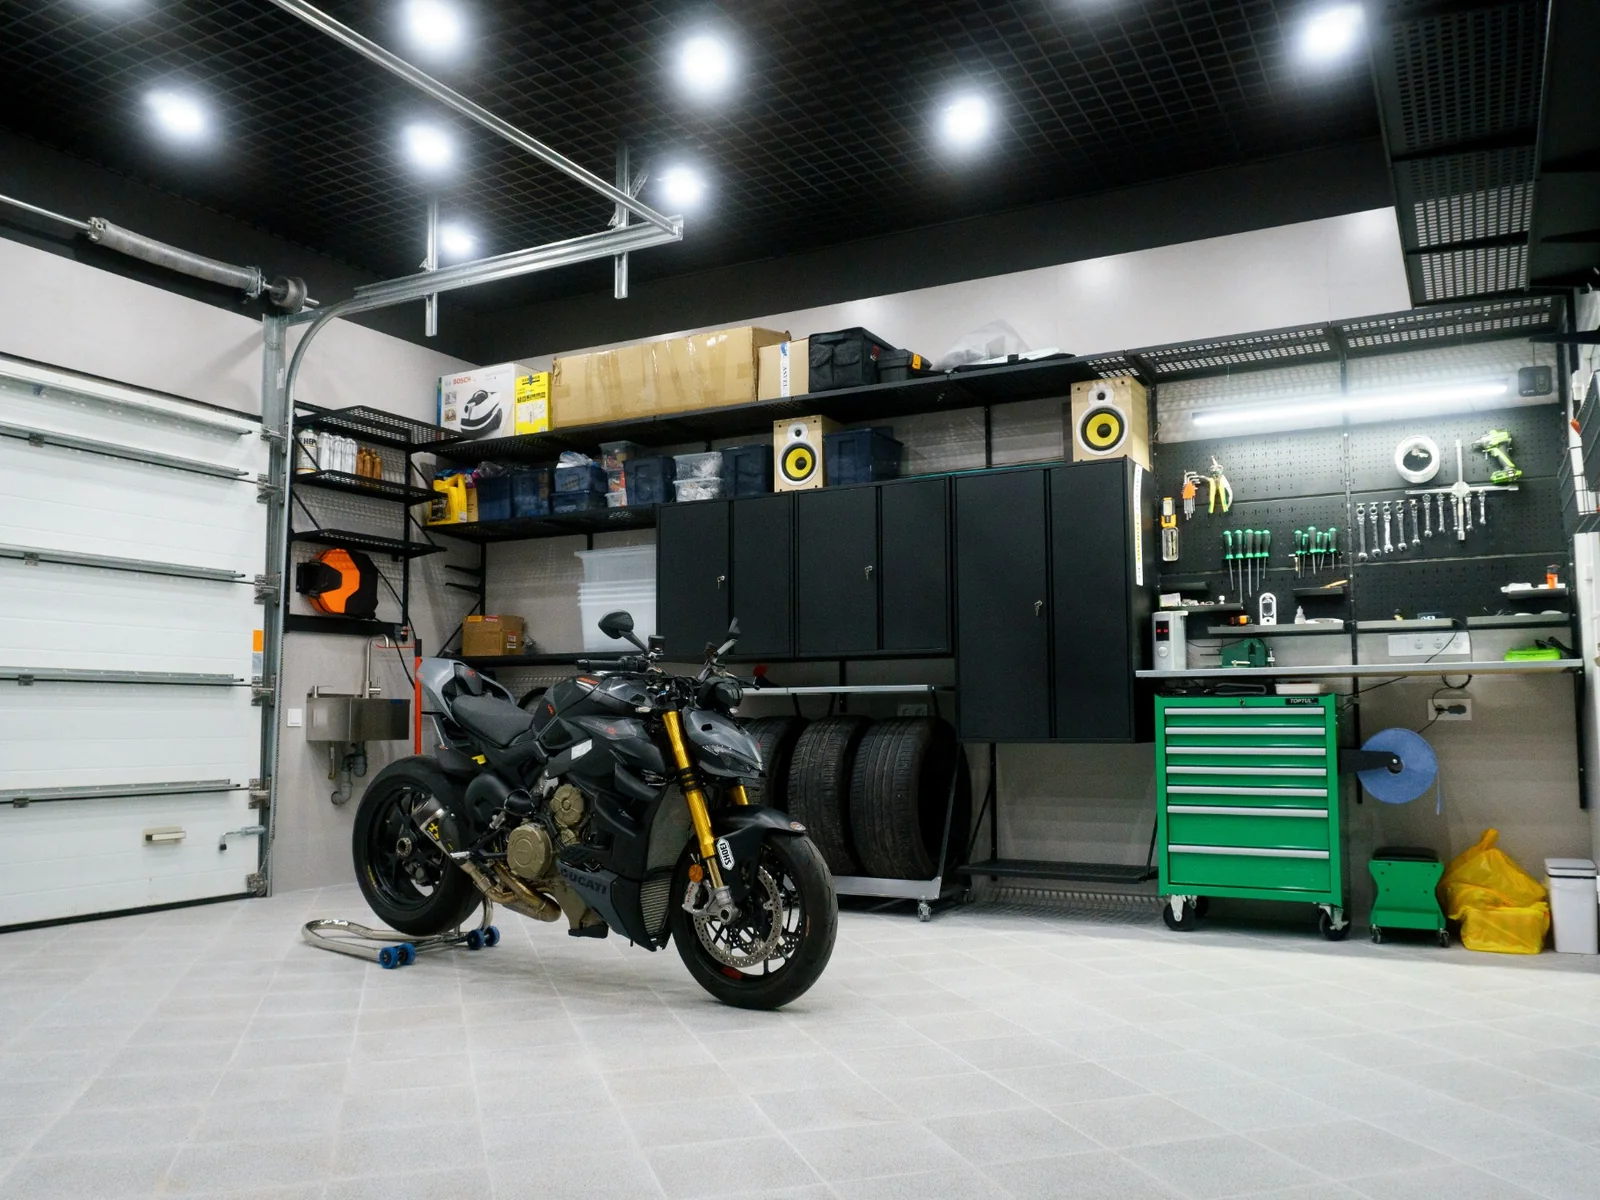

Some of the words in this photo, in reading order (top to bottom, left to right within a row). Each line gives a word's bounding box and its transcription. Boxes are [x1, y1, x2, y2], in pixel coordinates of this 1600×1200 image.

[453, 376, 471, 385] BOSCH
[720, 842, 732, 866] SHOEI
[561, 868, 607, 895] DUCATI
